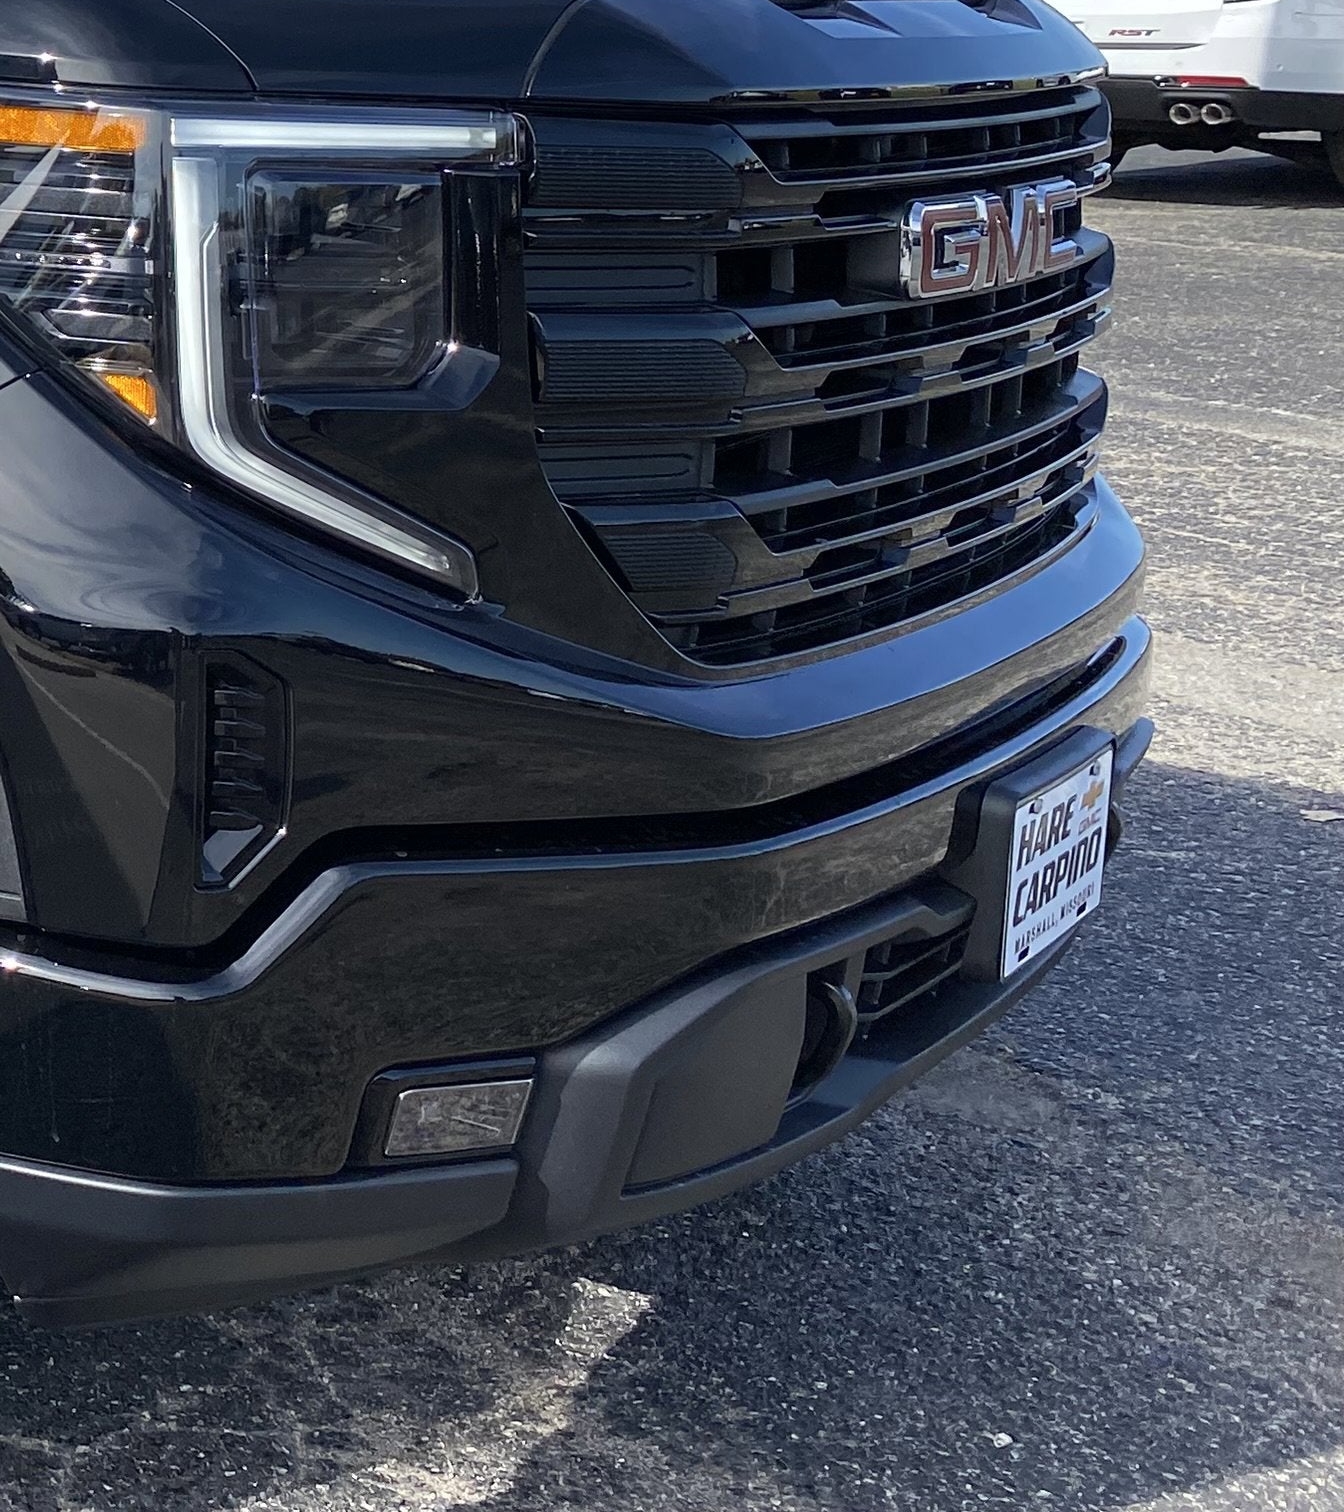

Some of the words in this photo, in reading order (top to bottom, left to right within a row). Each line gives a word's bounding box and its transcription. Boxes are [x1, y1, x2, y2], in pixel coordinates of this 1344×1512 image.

[1108, 29, 1161, 37] RST
[909, 180, 1077, 298] GMC
[1016, 793, 1077, 872] HARE
[1013, 826, 1102, 928] CARPINO
[1015, 910, 1059, 954] MARSHALL,
[1060, 880, 1096, 921] MISSOURI
